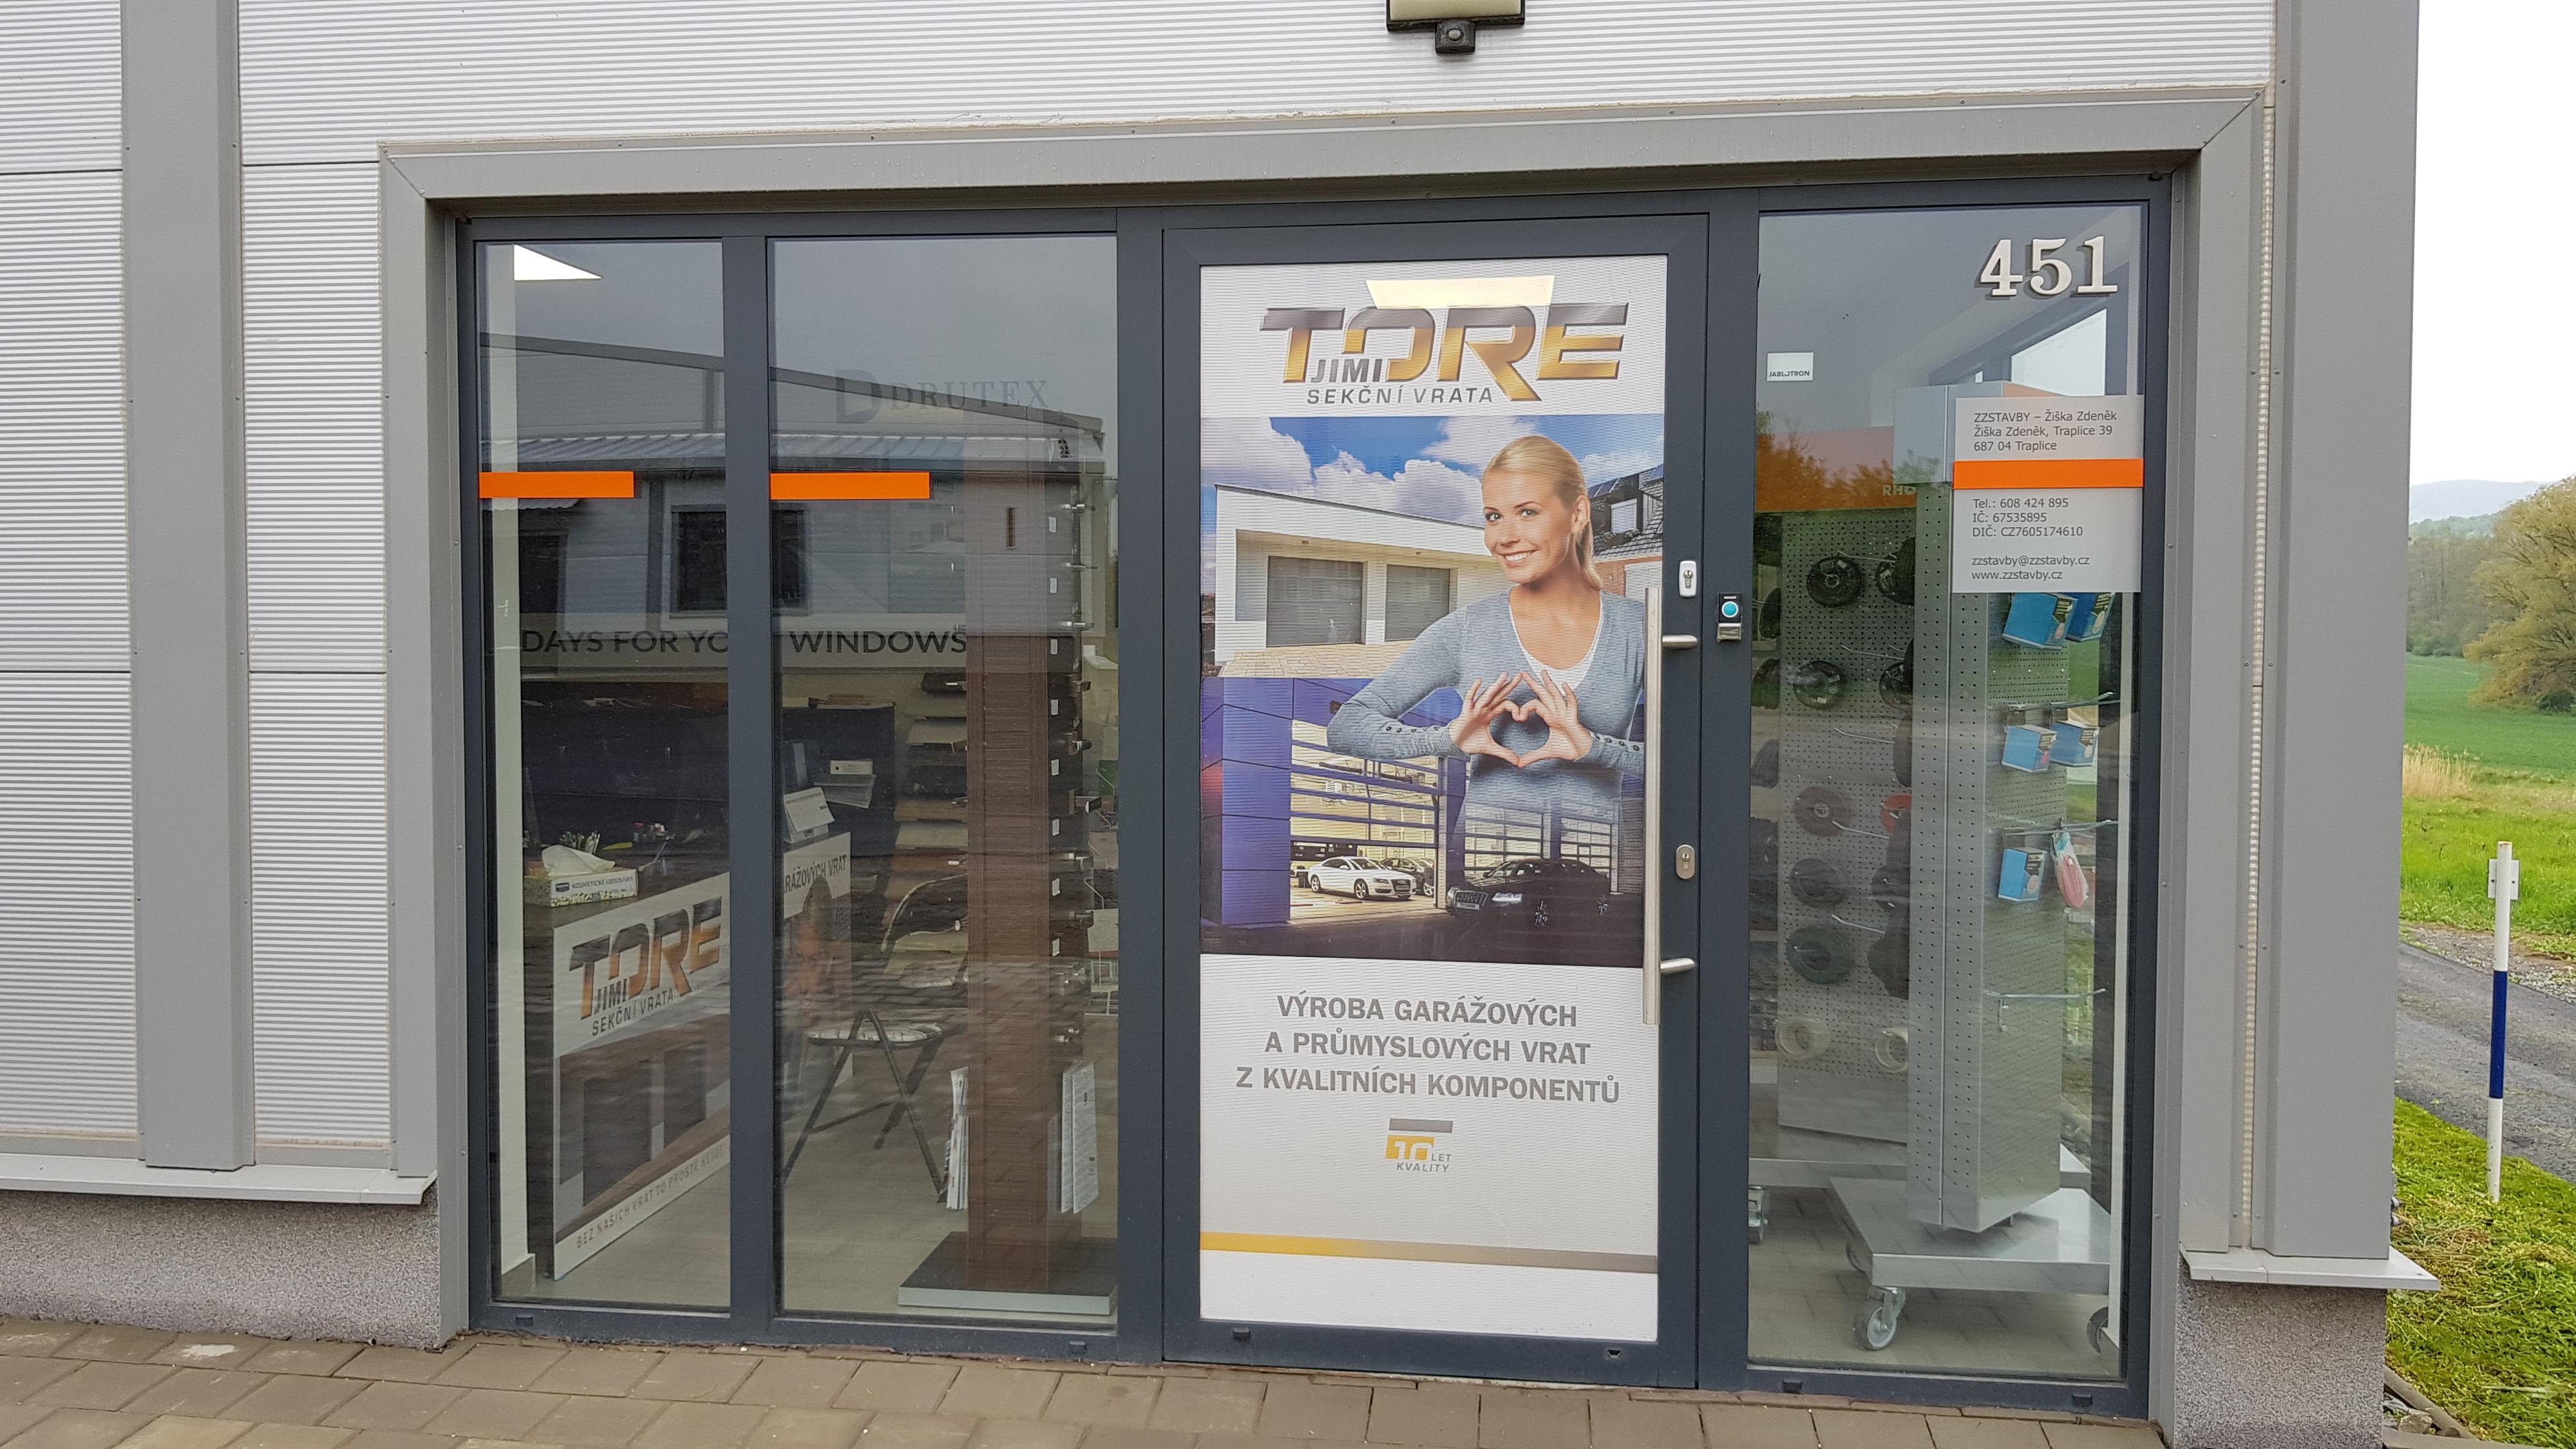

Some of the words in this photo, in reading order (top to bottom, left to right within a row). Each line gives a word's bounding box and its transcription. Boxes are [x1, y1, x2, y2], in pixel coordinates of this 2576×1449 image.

[1980, 236, 2118, 296] 451
[1260, 302, 1629, 401] TORE
[1310, 358, 1382, 383] JIMI
[890, 380, 1050, 411] DRUTEX
[1307, 384, 1404, 404] SEKČNÍ
[1414, 387, 1493, 404] VRATA
[1974, 412, 2031, 422] ZZSTAVBY
[2045, 409, 2072, 422] Žiška
[2077, 410, 2117, 421] Zdeněk
[1974, 424, 2002, 437] Žiška
[2006, 425, 2049, 438] Zdeněk,
[2054, 426, 2096, 437] Traplice
[2099, 426, 2112, 435] 39
[1974, 441, 1993, 451] 687
[1998, 441, 2011, 451] 04
[2015, 441, 2057, 452] Traplice
[1973, 498, 1996, 508] Tel.:
[2000, 498, 2020, 508] 608
[2024, 498, 2044, 507] 424
[2049, 498, 2069, 507] 895
[1973, 511, 1988, 523] IČ:
[1993, 513, 2047, 522] 67535895
[1973, 524, 1996, 537] DIČ:
[2001, 526, 2083, 536] CZ7605174610
[1972, 556, 2090, 567] zzstavby@zzstavby.cz
[1971, 570, 2063, 581] www.zzstavby.cz
[522, 630, 603, 653] DAYS
[614, 630, 679, 653] FOR
[790, 630, 966, 654] WINDOWS
[785, 860, 826, 893] RÁŽOVÝCH
[828, 854, 847, 876] VRAT
[569, 896, 723, 1021] TORE
[594, 978, 628, 1015] JIMI
[1277, 990, 1384, 1021] VÝROBA
[1394, 996, 1577, 1027] GARÁŽOVÝCH
[592, 999, 637, 1036] SEKČNÍ
[640, 988, 674, 1015] VRATA
[1264, 1032, 1283, 1053] A
[1293, 1028, 1510, 1062] PRŮMYSLOVÝCH
[1520, 1041, 1591, 1065] VRAT
[1236, 1066, 1253, 1088] Z
[1264, 1066, 1416, 1095] KVALITNÍCH
[1428, 1075, 1620, 1103] KOMPONENTŮ
[1396, 1162, 1450, 1173] KVALITY
[1432, 1153, 1452, 1162] LET
[576, 1227, 594, 1249] BEZ
[596, 1204, 630, 1235] NAŠICH
[632, 1189, 654, 1211] VRAT
[656, 1181, 667, 1196] TO
